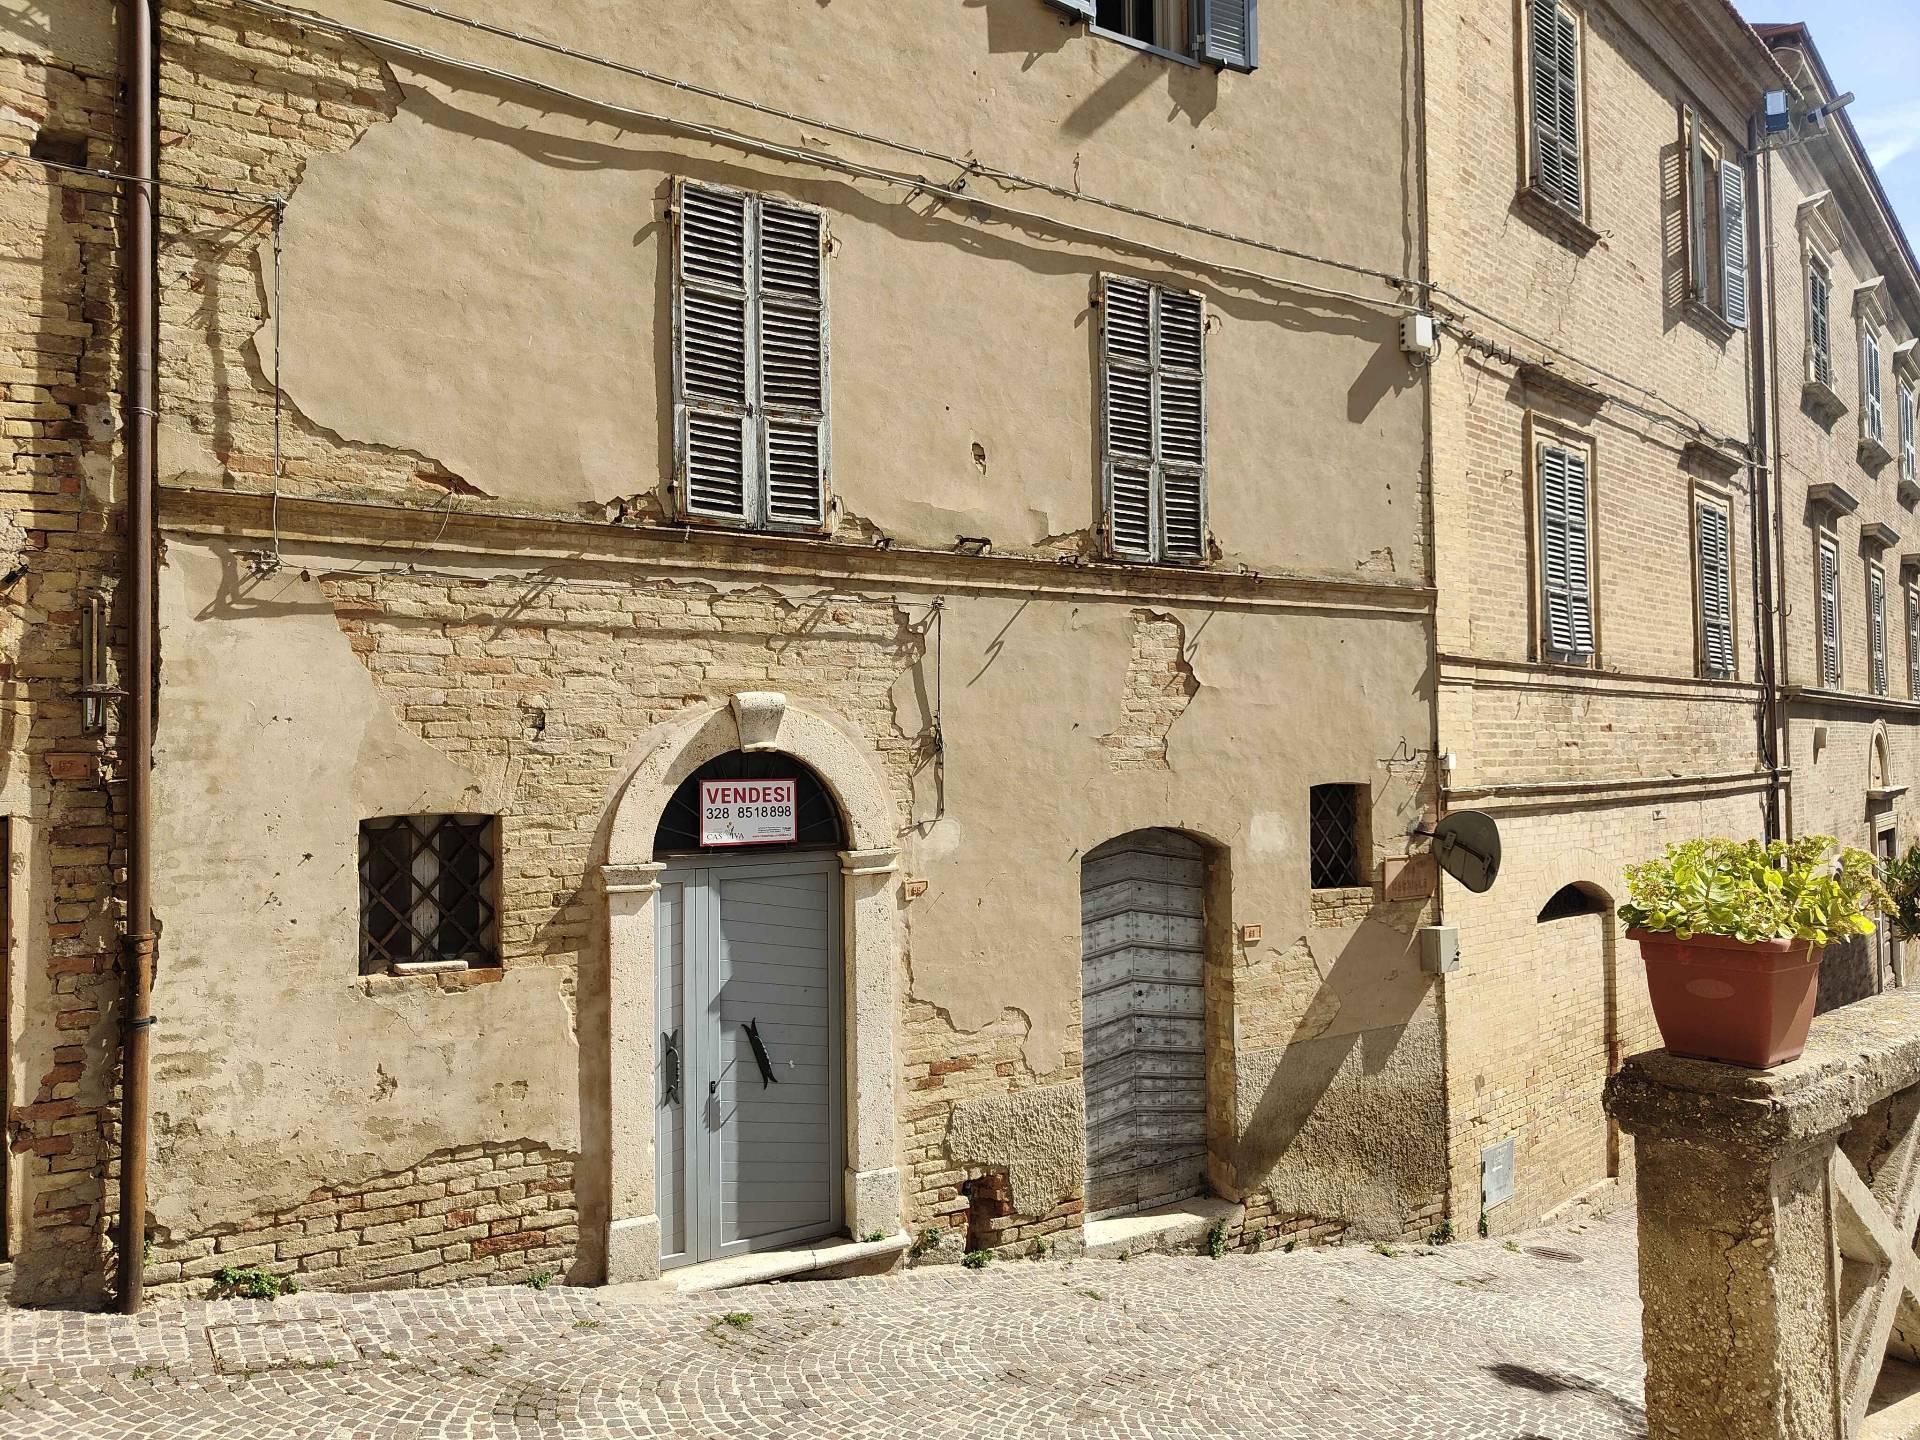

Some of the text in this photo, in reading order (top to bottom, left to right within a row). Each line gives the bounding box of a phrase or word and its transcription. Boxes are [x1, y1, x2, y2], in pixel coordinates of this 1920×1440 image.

[706, 786, 791, 804] VENDESI
[706, 806, 792, 820] 328 8518898
